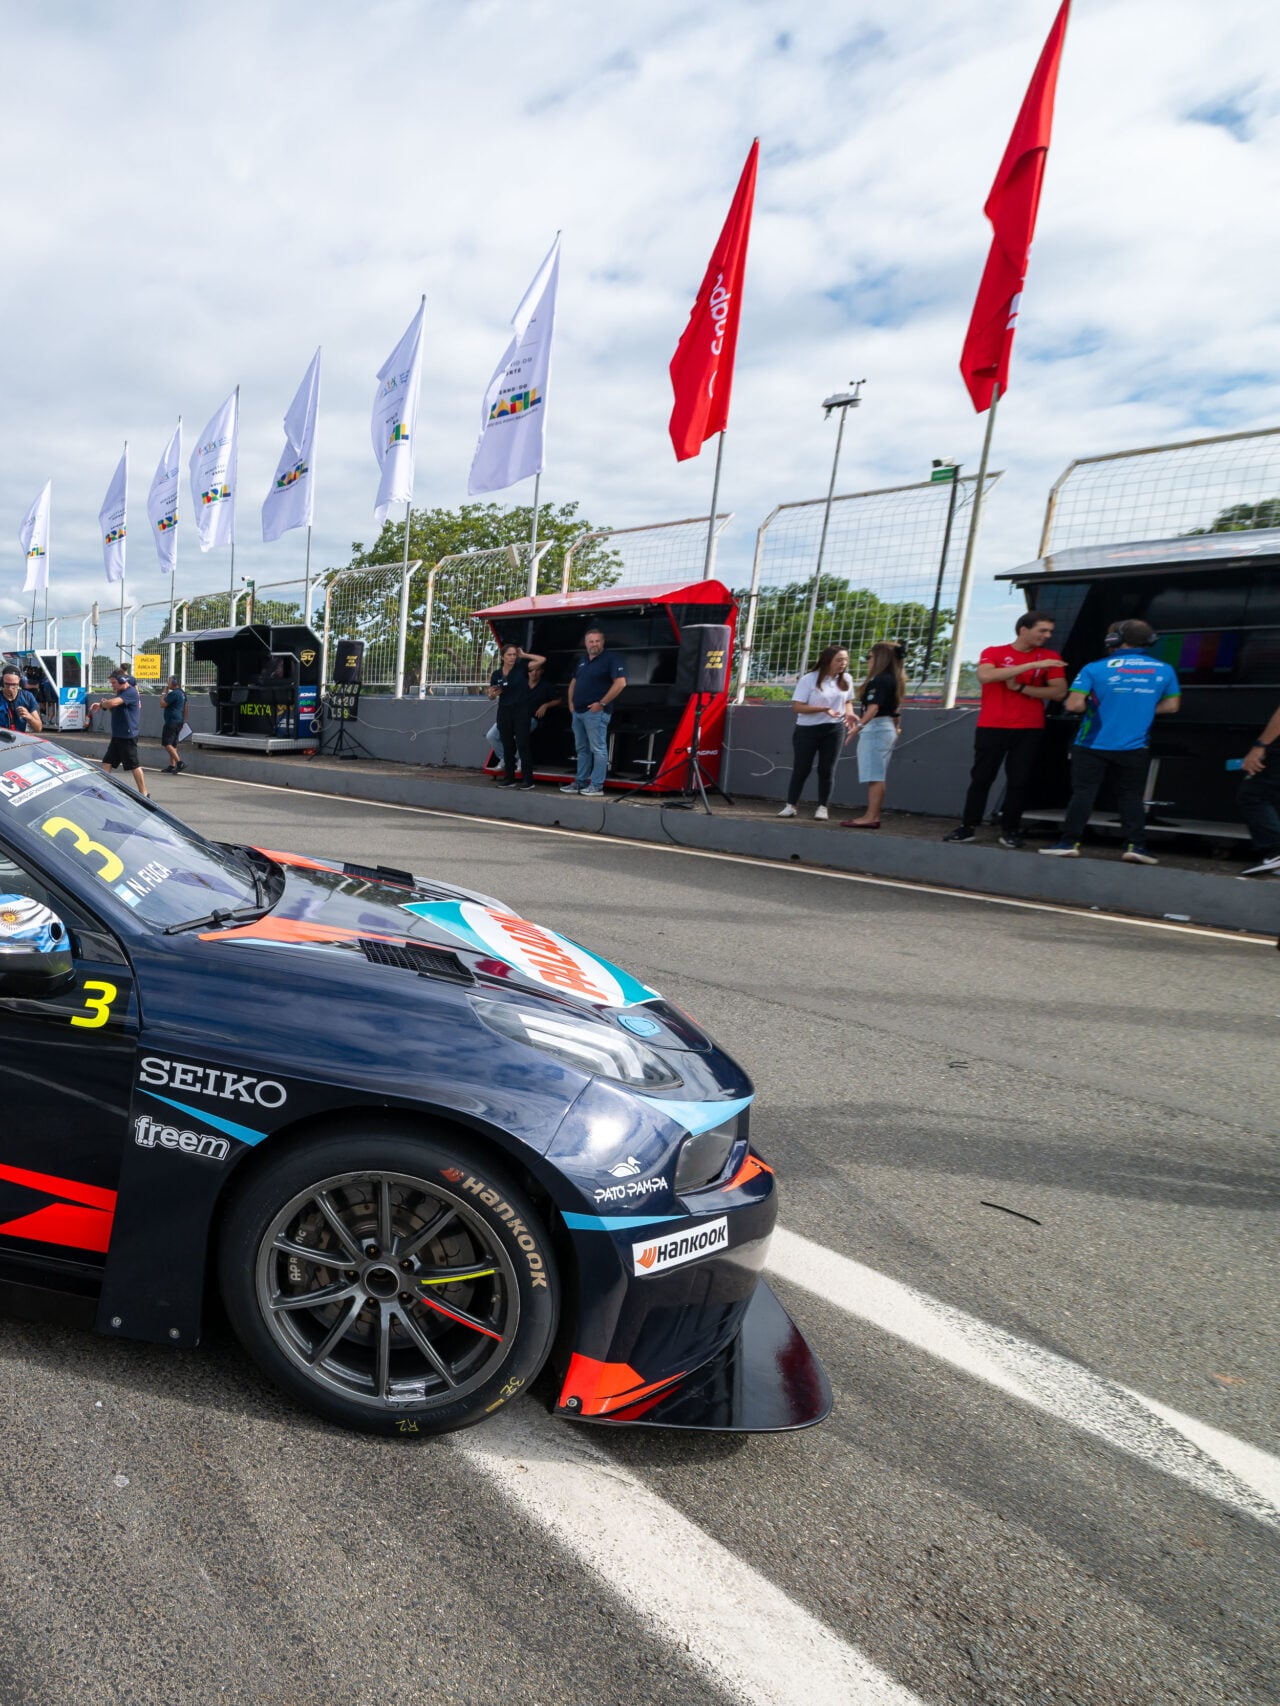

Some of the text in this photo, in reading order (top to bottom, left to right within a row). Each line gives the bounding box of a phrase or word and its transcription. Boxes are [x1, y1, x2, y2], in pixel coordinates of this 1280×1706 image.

[240, 704, 272, 716] NEXTA
[41, 816, 124, 883] 3
[127, 860, 172, 897] N. FUCA
[70, 980, 118, 1029] 3
[139, 1056, 287, 1109] SEIKO
[135, 1115, 231, 1161] freem
[594, 1176, 669, 1203] PATO PAMPA
